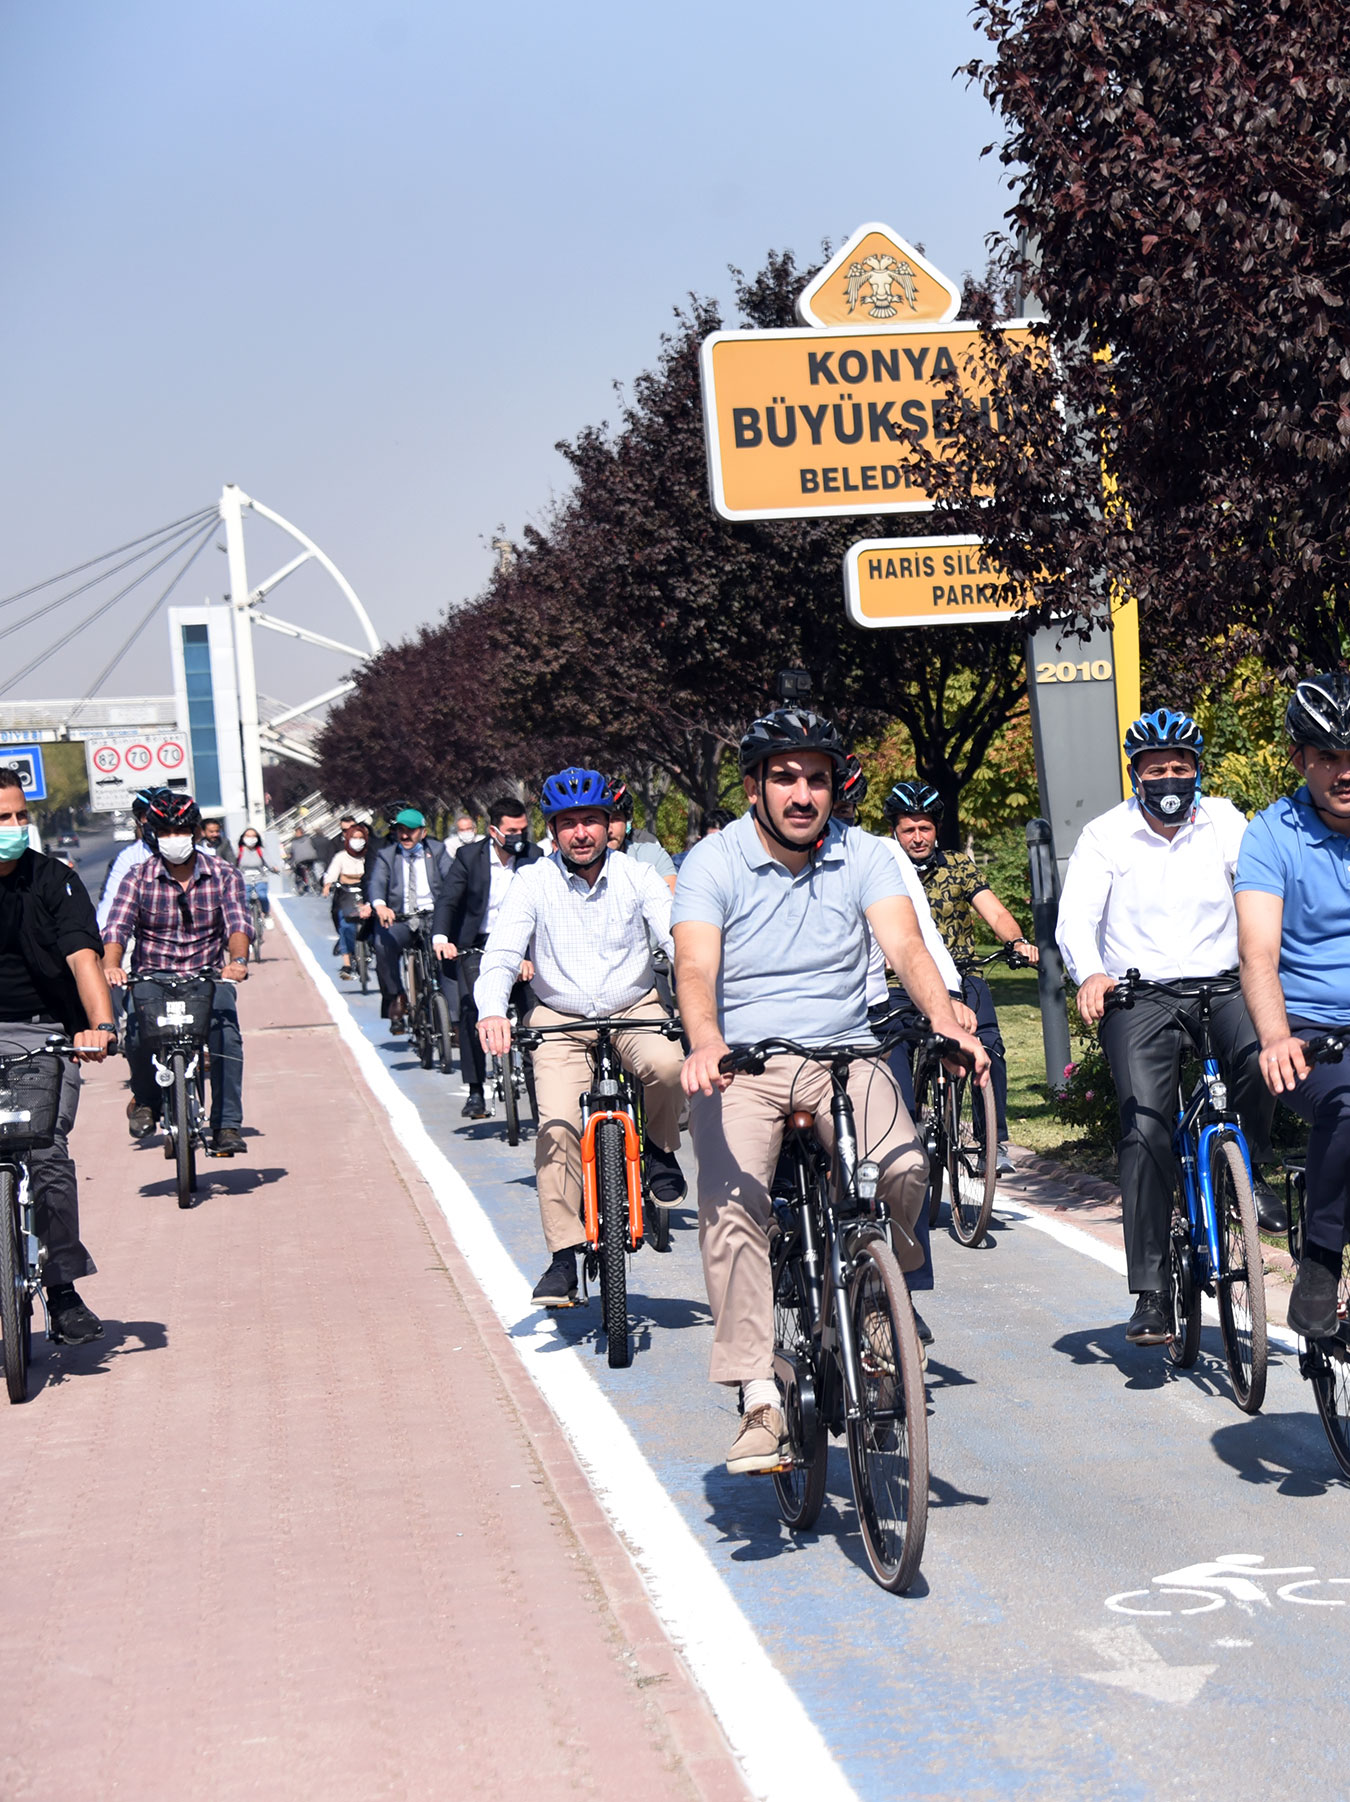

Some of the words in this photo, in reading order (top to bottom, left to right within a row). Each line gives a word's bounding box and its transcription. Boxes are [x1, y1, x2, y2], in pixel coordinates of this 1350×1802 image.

[808, 346, 957, 385] KONYA
[869, 552, 935, 579] HARİS
[932, 584, 998, 606] PARK
[1036, 660, 1112, 684] 2010
[131, 750, 149, 765] 70
[163, 748, 181, 763] 70
